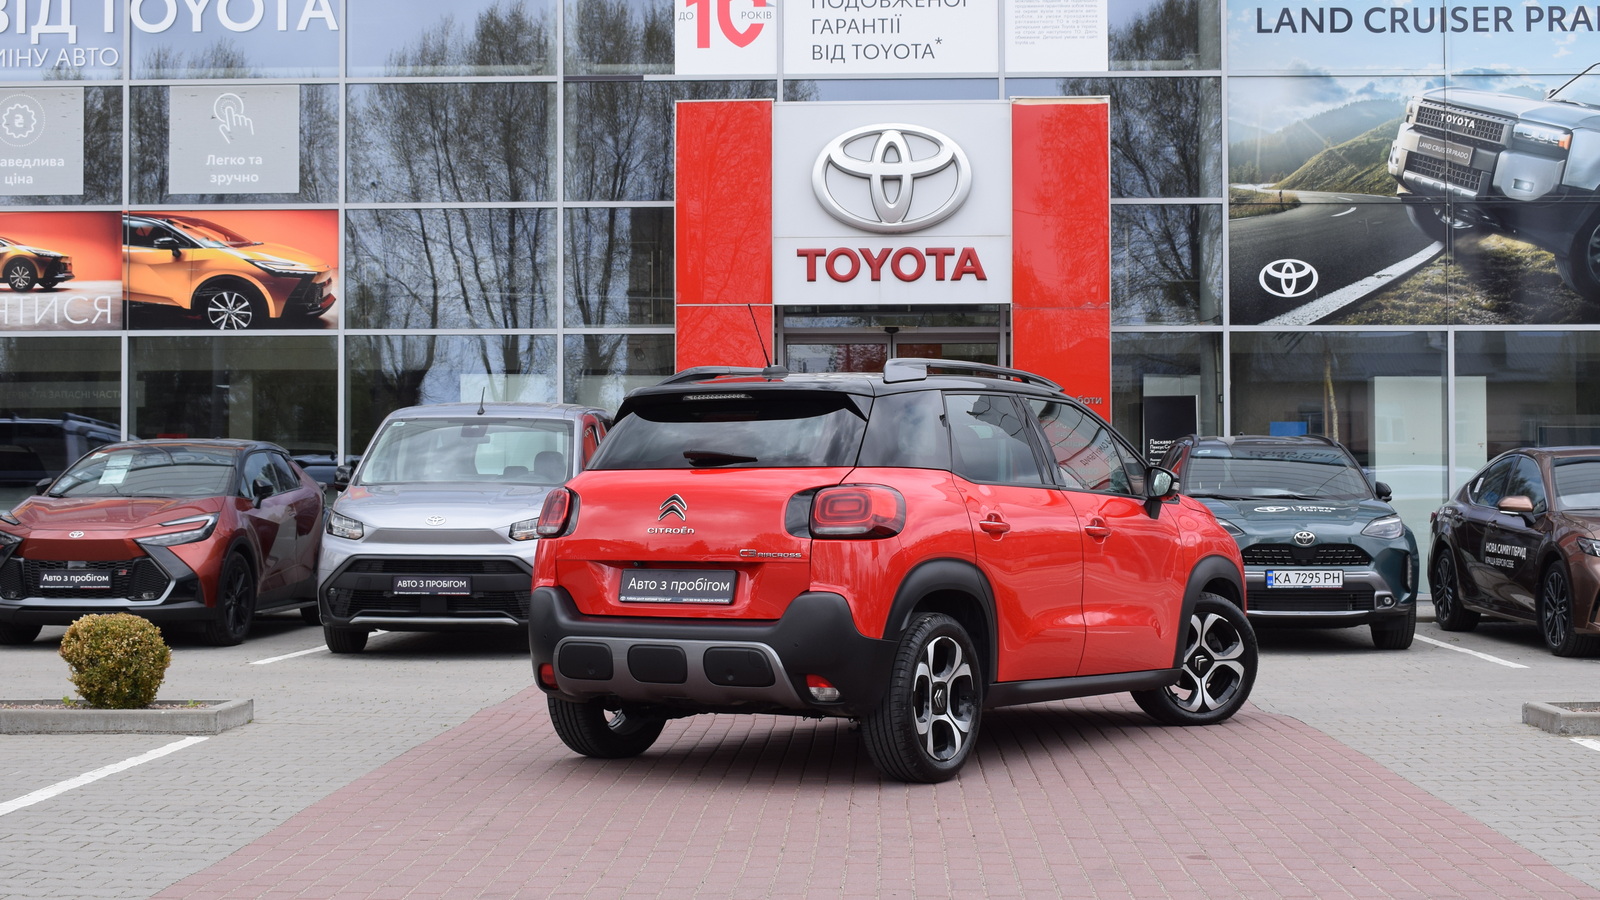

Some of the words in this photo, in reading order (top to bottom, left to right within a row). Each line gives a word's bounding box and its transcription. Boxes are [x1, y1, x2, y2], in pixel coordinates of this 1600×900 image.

[678, 12, 694, 21] ДО
[741, 11, 772, 20] РОКІВ
[1256, 7, 1353, 34] LAND
[1364, 6, 1514, 34] CRUISER
[1526, 5, 1600, 32] PRA
[812, 14, 902, 34] ГАРАНТІЇ
[55, 47, 119, 67] АВТО
[812, 44, 846, 63] ВІД
[1440, 113, 1475, 129] TOYOTA
[1419, 141, 1432, 150] LAND
[205, 154, 246, 166] Легко
[248, 156, 263, 165] та
[4, 172, 34, 187] ціна
[210, 173, 259, 187] зручно
[797, 246, 987, 282] TOYOTA
[647, 526, 696, 534] CITROËN
[42, 574, 62, 582] Авто
[70, 574, 109, 583] пробігом
[628, 577, 657, 590] Авто
[660, 580, 667, 590] з
[670, 578, 730, 594] пробігом
[1274, 573, 1291, 584] KA
[1295, 572, 1320, 584] 7295
[1324, 572, 1340, 584] PH
